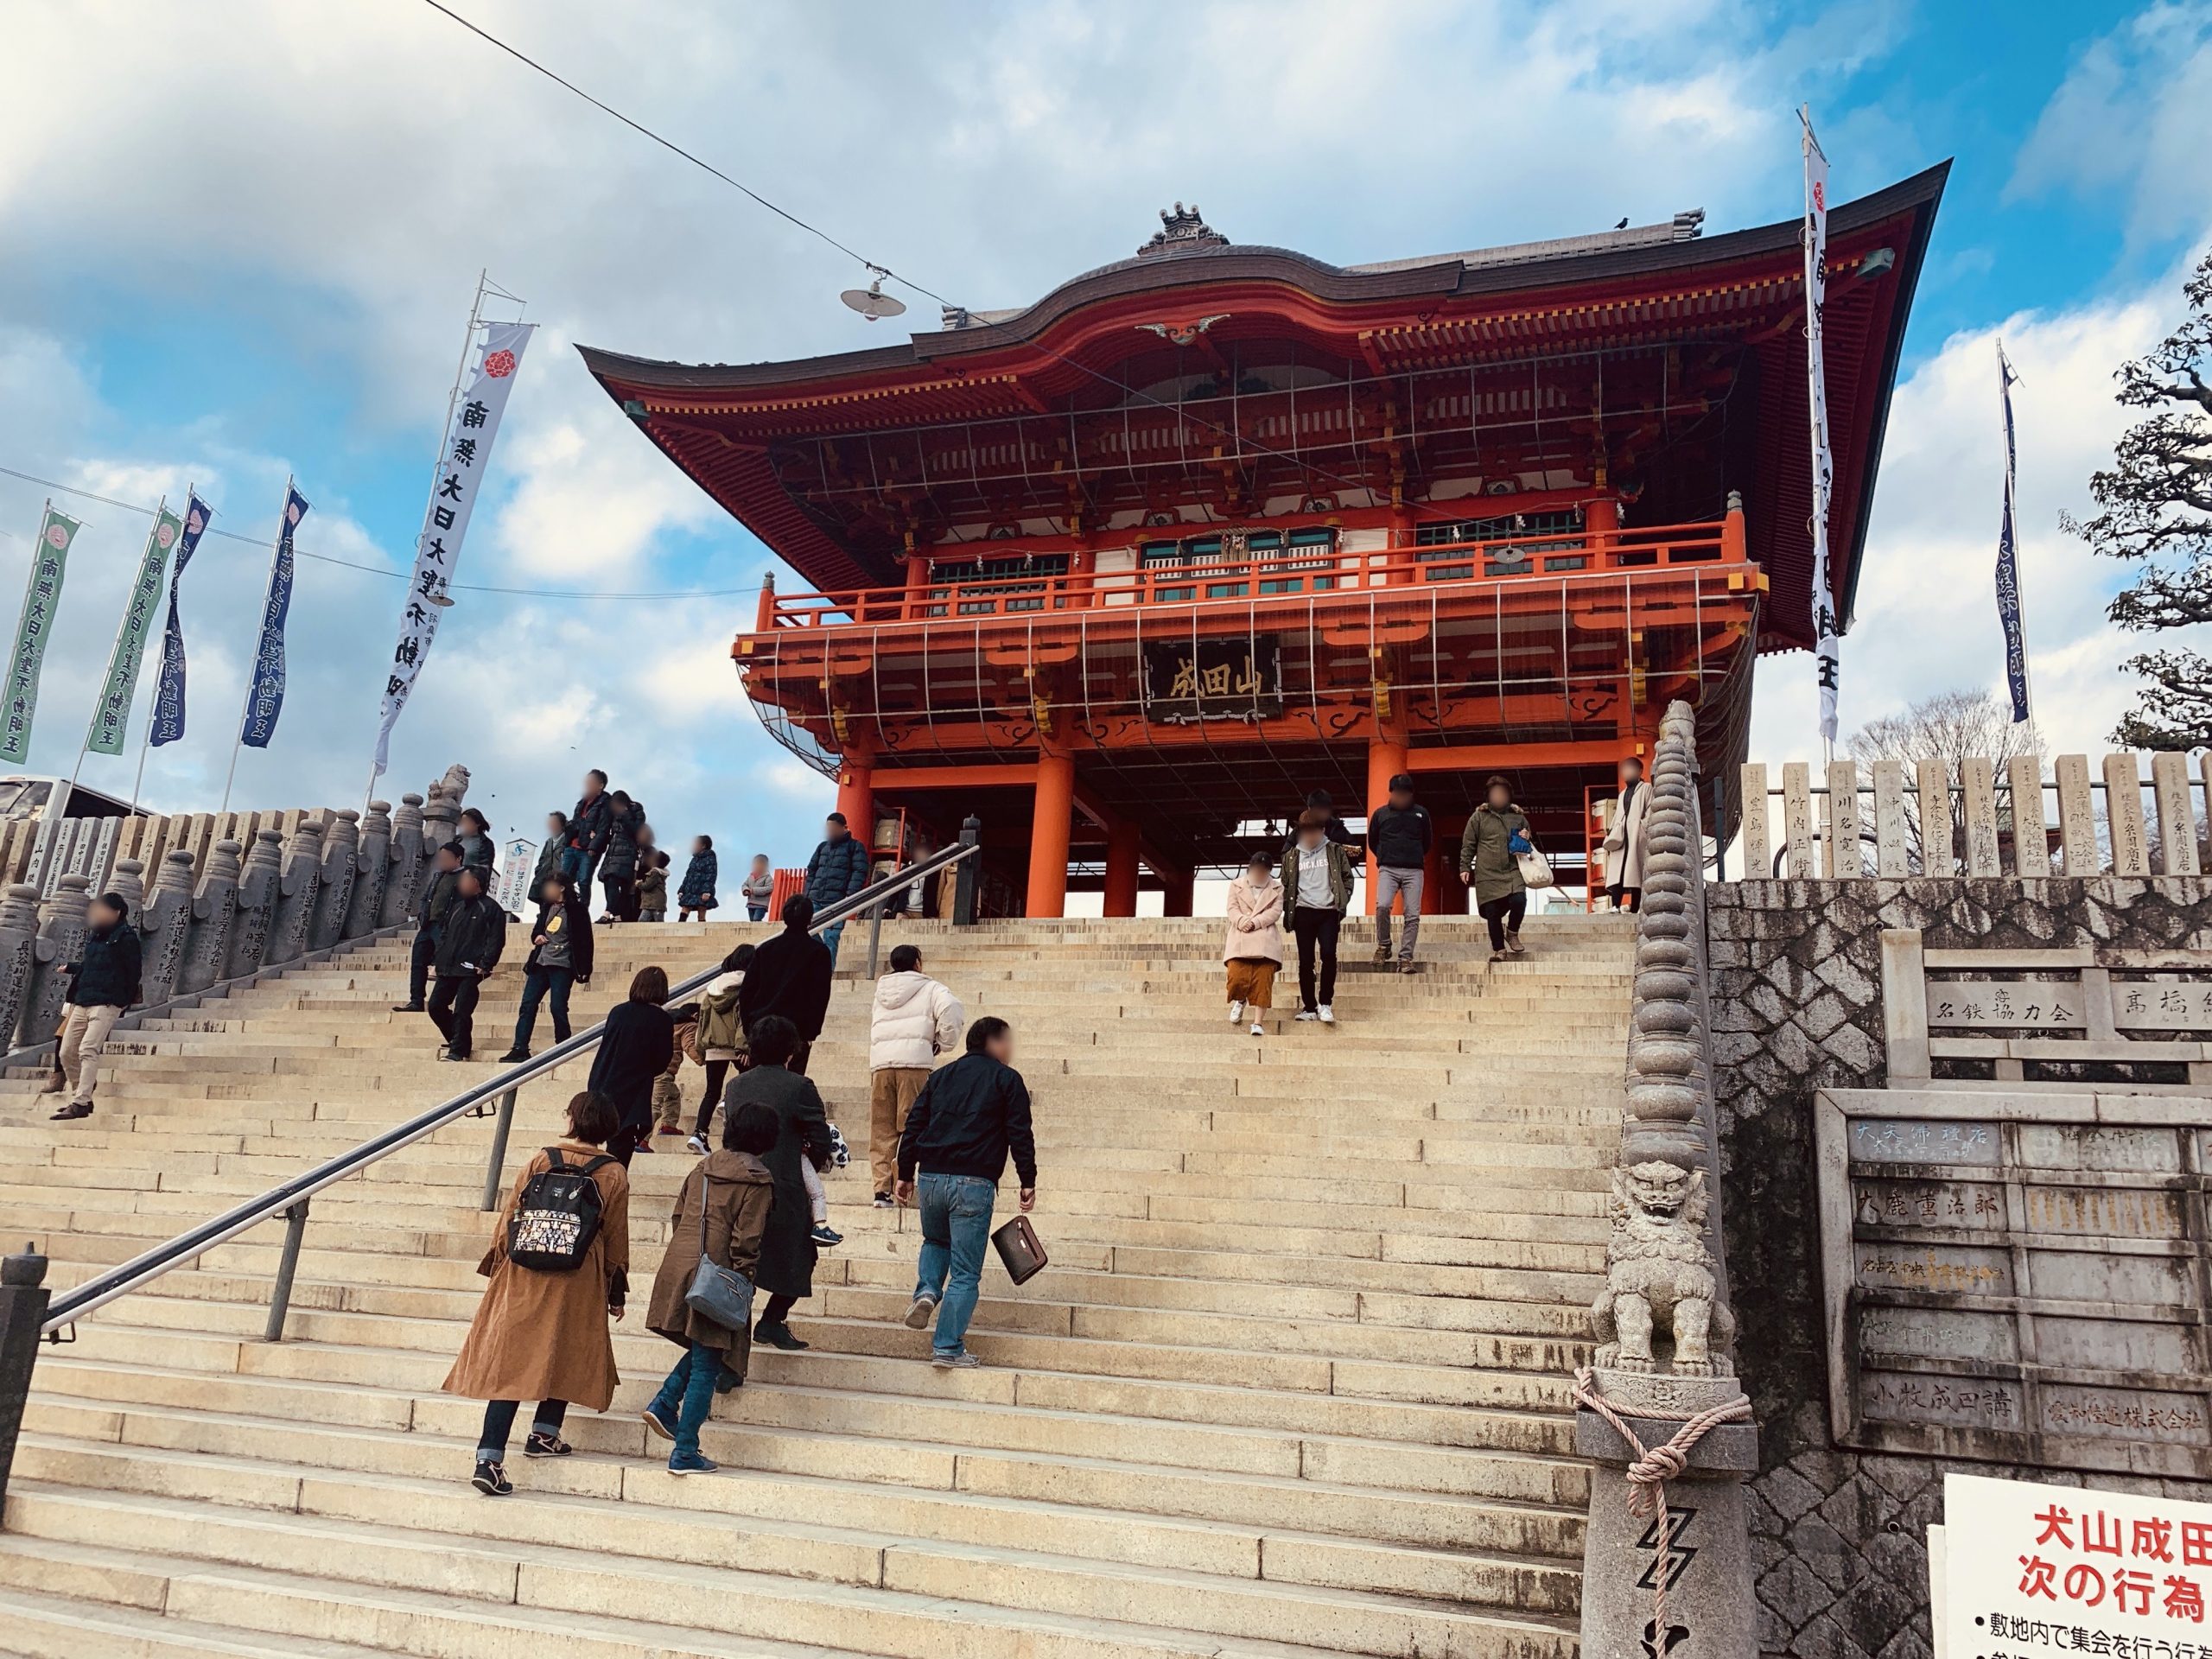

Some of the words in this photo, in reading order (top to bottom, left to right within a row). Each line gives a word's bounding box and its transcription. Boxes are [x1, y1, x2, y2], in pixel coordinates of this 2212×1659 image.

[1170, 655, 1262, 698] 成田山
[1936, 1002, 2073, 1022] 名鉄協力会
[1859, 1189, 1999, 1217] 大鹿重治郎
[2034, 1504, 2212, 1567] 犬山成田
